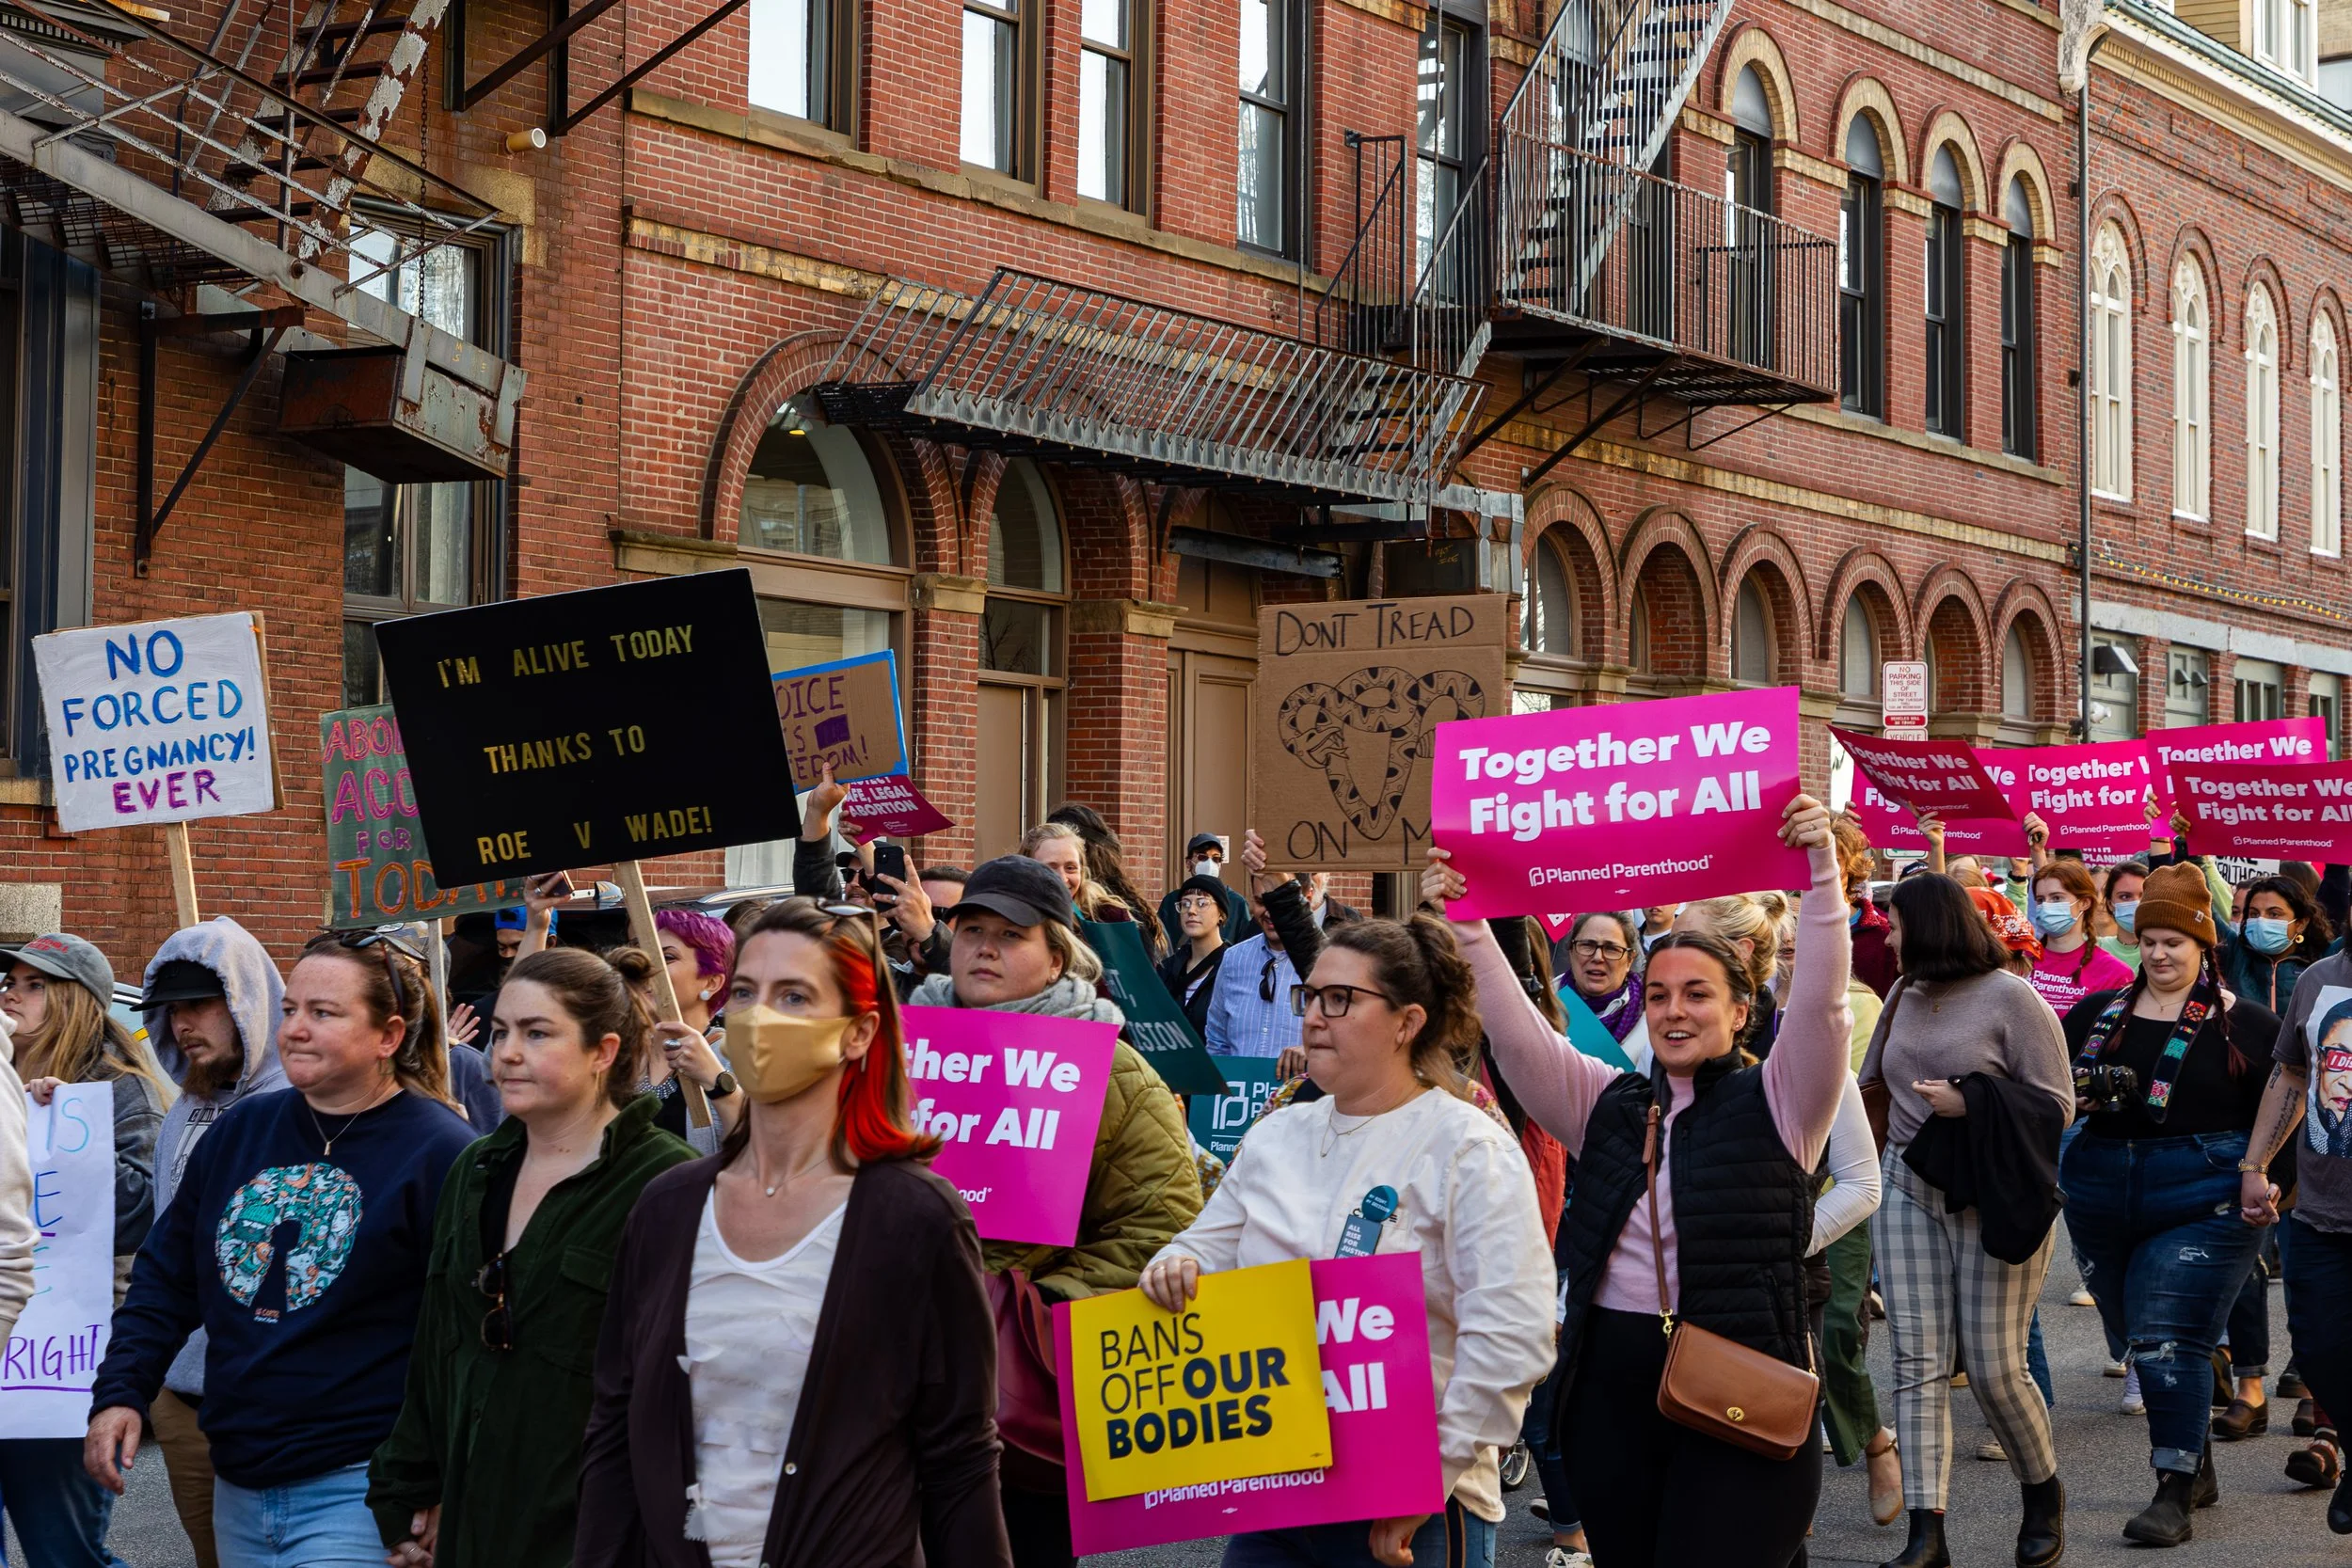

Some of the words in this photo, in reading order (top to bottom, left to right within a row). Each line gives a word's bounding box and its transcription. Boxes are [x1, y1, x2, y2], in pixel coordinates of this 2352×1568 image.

[1276, 610, 1359, 656] DONT
[1366, 603, 1474, 648] TREAD
[105, 629, 183, 680] NO
[437, 657, 482, 688] I'M
[513, 641, 589, 676] ALIVE
[611, 625, 692, 662] TODAY
[62, 679, 243, 737] FORCED
[63, 726, 255, 783] PREGNANCY!
[484, 732, 593, 774] THANKS
[609, 725, 646, 755] TO
[1459, 732, 1680, 784] Together
[1690, 721, 1771, 756] We
[1842, 739, 1928, 769] Together
[1929, 754, 1970, 769] We
[2269, 736, 2312, 757] We
[113, 768, 221, 814] EVER
[869, 785, 913, 800] LEGAL
[1908, 775, 1942, 791] for
[1947, 775, 1980, 790] All
[2031, 789, 2094, 814] Fight
[2097, 785, 2137, 806] for
[2185, 776, 2308, 800] Together
[849, 800, 919, 817] ABORTION
[1470, 789, 1595, 842] Fight
[1604, 782, 1679, 823] for
[1691, 770, 1762, 816] All
[2198, 801, 2268, 826] Fight
[2272, 803, 2313, 821] for
[357, 828, 412, 858] FOR
[477, 831, 532, 864] ROE
[573, 821, 591, 848] V
[625, 806, 713, 843] WADE!
[1287, 820, 1347, 861] ON
[2069, 825, 2102, 834] Planned
[2243, 837, 2280, 846] Planned
[2280, 838, 2332, 847] Parenthood
[1546, 862, 1611, 884] Planned
[1613, 855, 1710, 879] Parenthood
[2032, 980, 2086, 996] Parenthood
[1005, 1048, 1081, 1092] We
[985, 1108, 1060, 1149] All
[1343, 1238, 1359, 1247] FOR
[1346, 1230, 1361, 1241] RISE
[1348, 1224, 1361, 1233] ALL
[4, 1324, 104, 1381] RIGHT
[1100, 1312, 1205, 1370] BANS
[1101, 1363, 1175, 1414] OFF
[1183, 1347, 1290, 1400] OUR
[1106, 1395, 1273, 1460] BODIES
